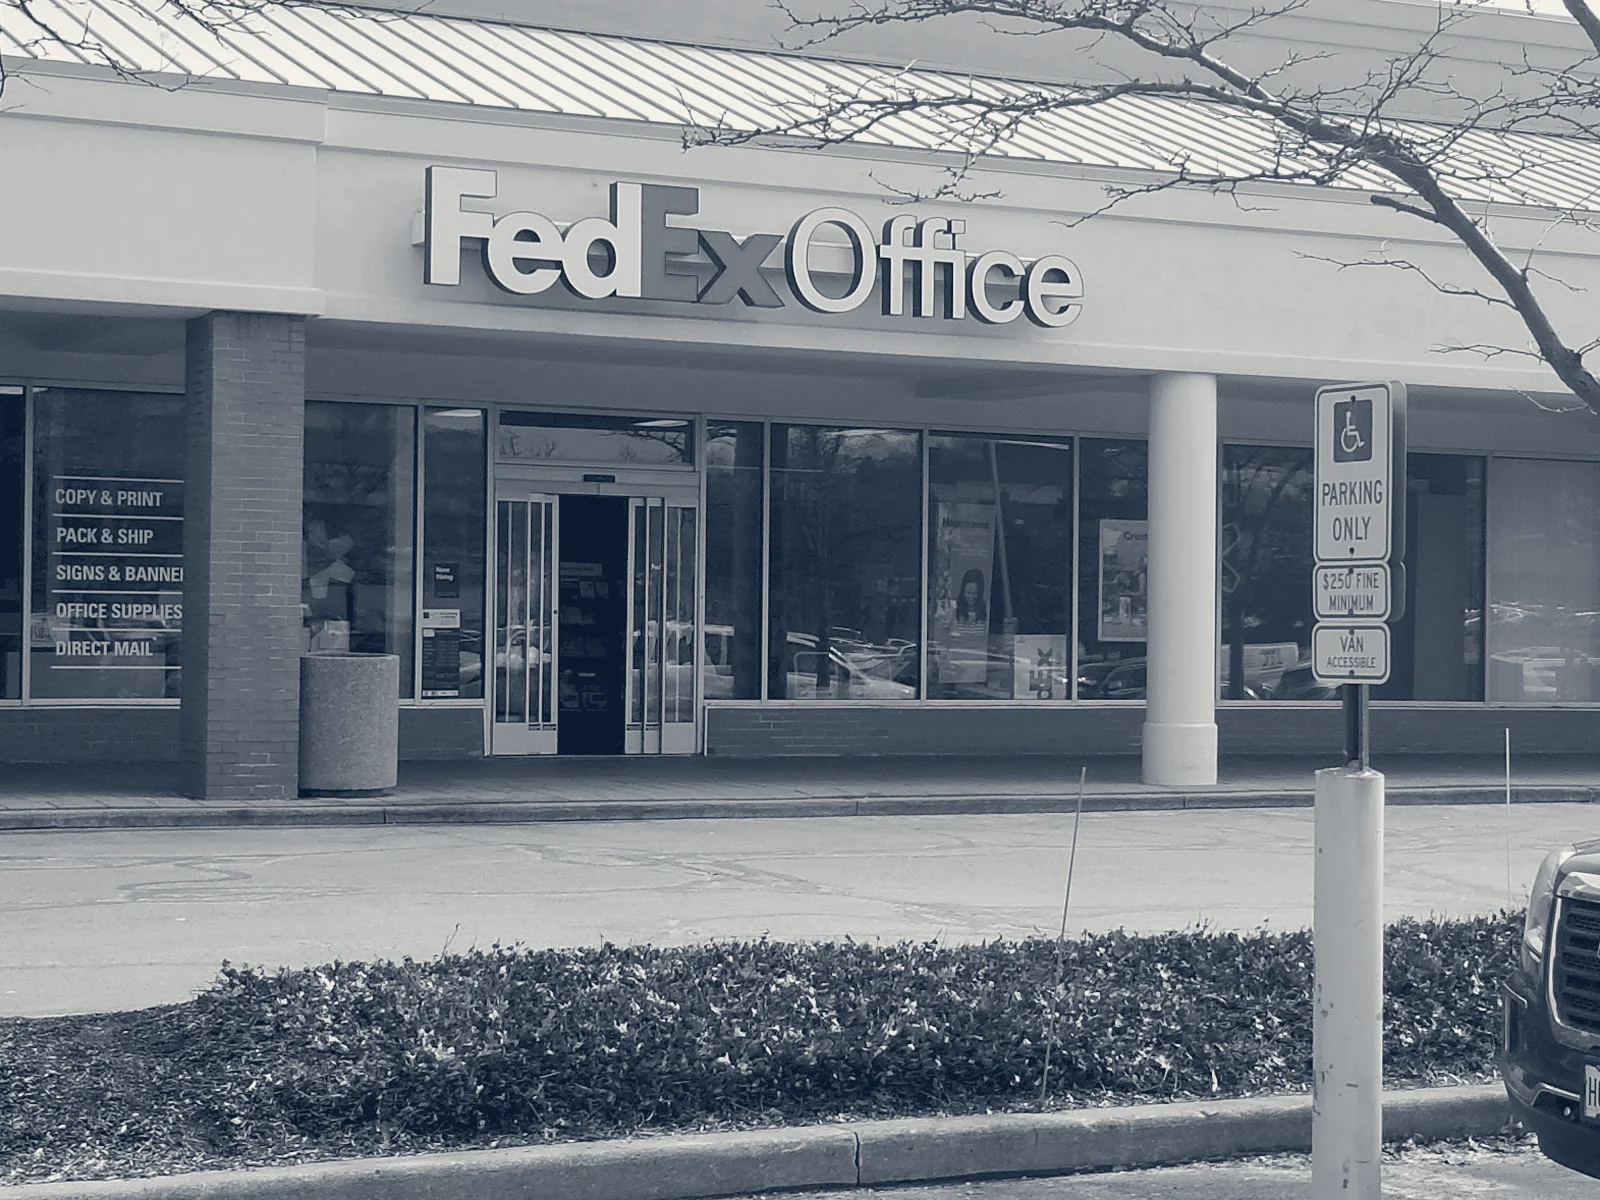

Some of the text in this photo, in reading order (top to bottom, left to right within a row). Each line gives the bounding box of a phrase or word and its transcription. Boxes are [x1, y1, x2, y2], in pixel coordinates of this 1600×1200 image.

[425, 165, 1085, 327] FedEx Office
[55, 488, 163, 507] COPY & PRINT
[1321, 479, 1383, 506] PARKING
[56, 527, 154, 544] PACK & SHIP
[1332, 516, 1372, 542] ONLY
[56, 565, 184, 582] SIGNS & BANNE
[1323, 572, 1380, 591] $250 FINE
[56, 603, 183, 620] OFFICE SUPPLIES
[1329, 594, 1375, 612] MINIMUM
[55, 641, 154, 657] DIRECT MAIL
[1340, 636, 1364, 653] VAN
[1326, 656, 1377, 669] ACCESSIBLE
